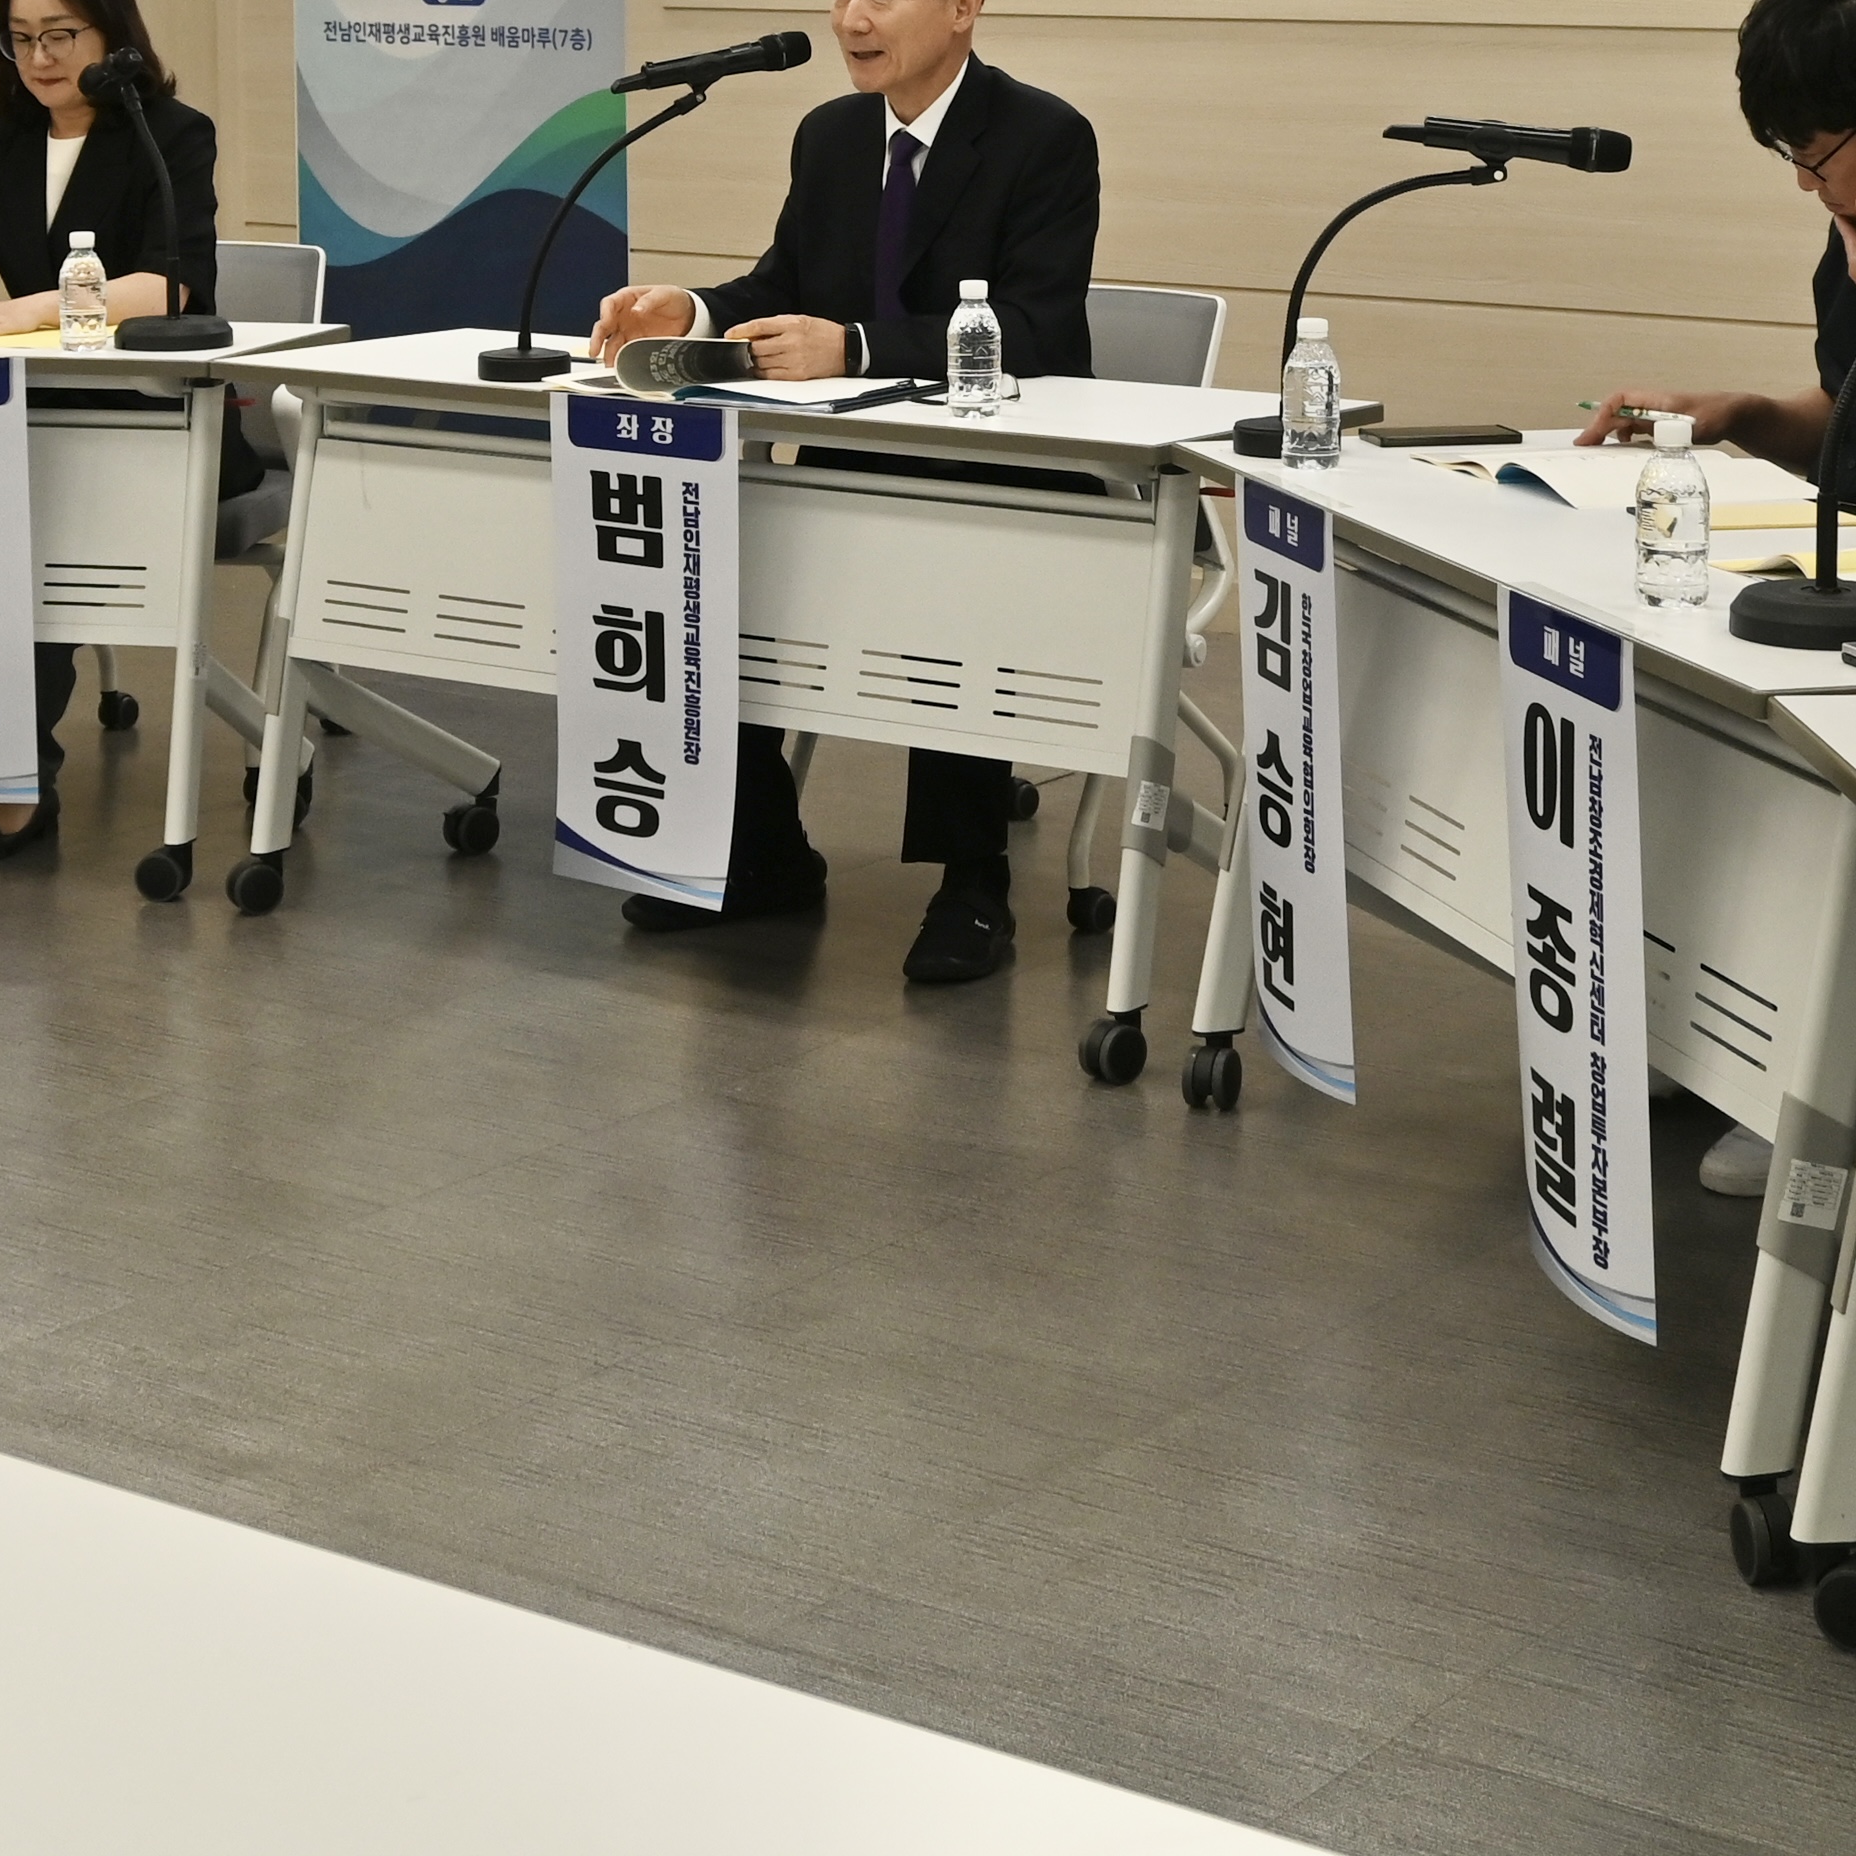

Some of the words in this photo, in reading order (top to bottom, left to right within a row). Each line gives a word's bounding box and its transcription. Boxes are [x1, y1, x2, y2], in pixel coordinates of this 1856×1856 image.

[323, 20, 486, 48] 전남인재평생교육진흥원
[490, 25, 593, 52] 배움마루(7층)
[589, 469, 667, 838] 범희승
[681, 481, 702, 766] 전남인재평생교육진흥원장
[1254, 569, 1295, 1012] 김승현
[1523, 702, 1577, 1228] 이종렬
[1588, 733, 1607, 1046] 전남창조경제혁신센터
